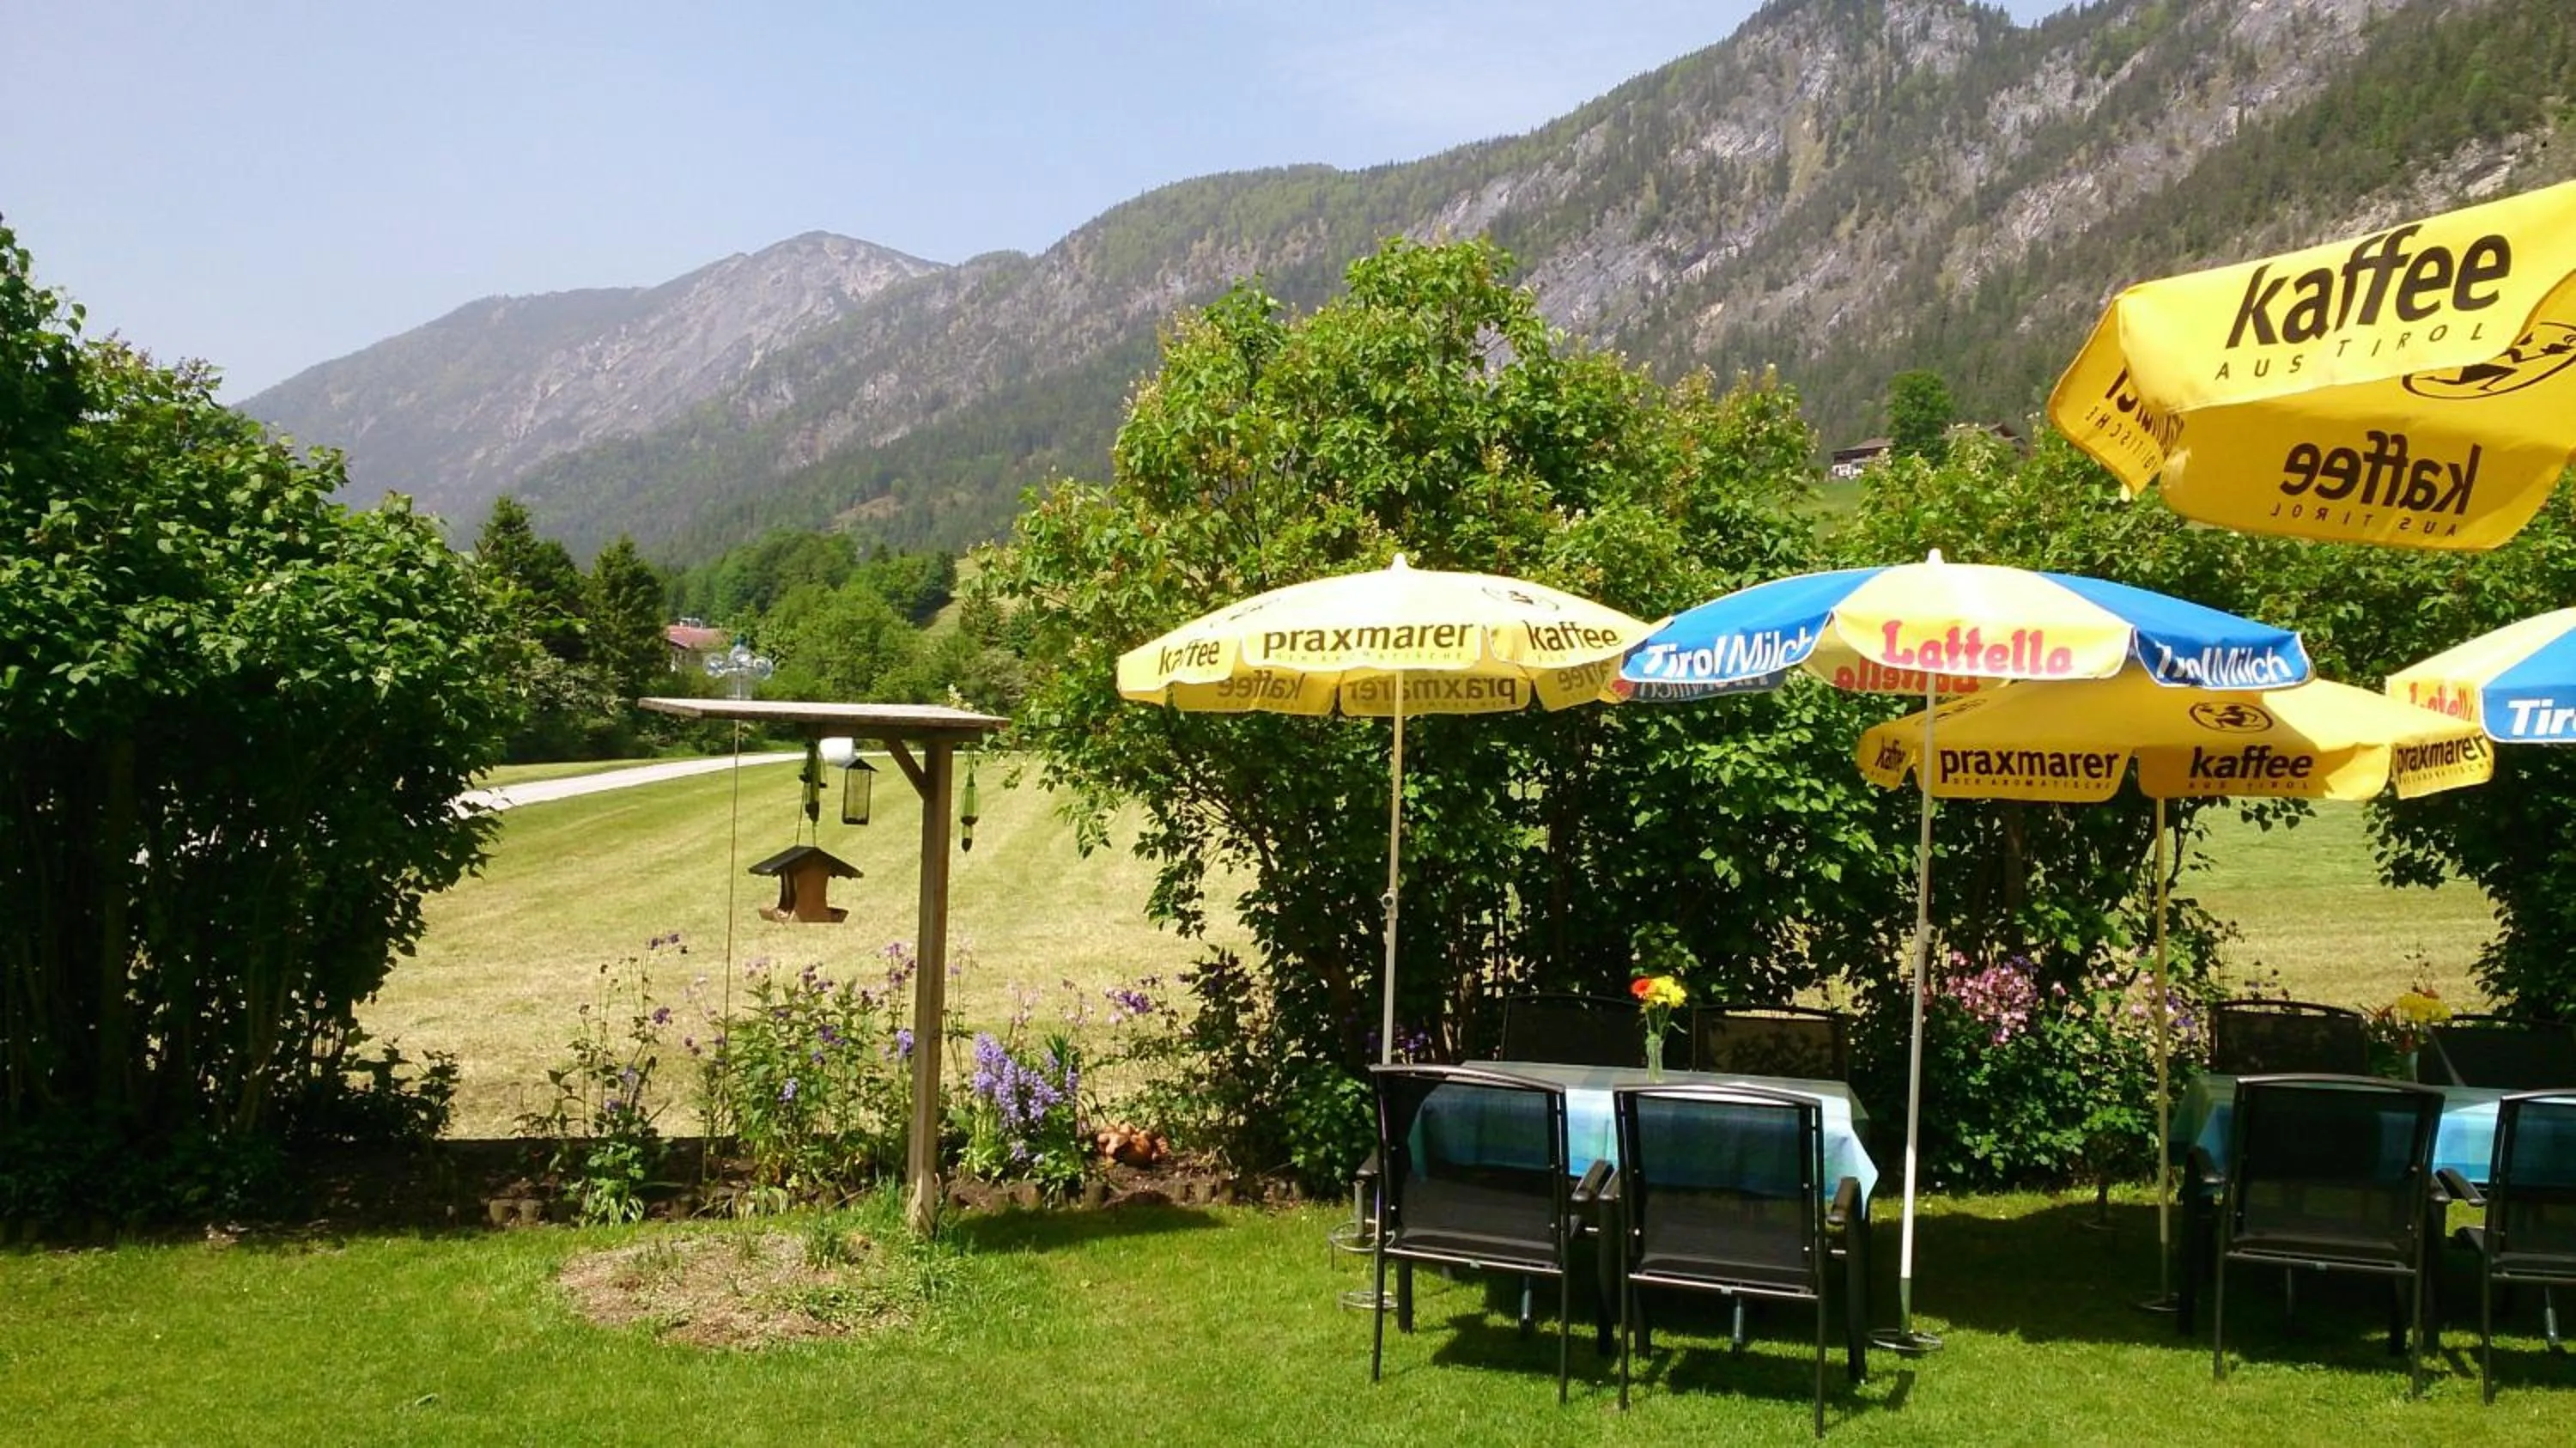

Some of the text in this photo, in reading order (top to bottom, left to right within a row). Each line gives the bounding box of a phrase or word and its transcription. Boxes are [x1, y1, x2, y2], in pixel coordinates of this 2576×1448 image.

[2226, 224, 2512, 349] kaffee
[2215, 323, 2483, 380] AUS TIROL
[1263, 624, 1474, 660] praxmarer
[1522, 620, 1623, 651] kaffee
[1881, 619, 2074, 676] Lattella
[2508, 698, 2576, 736] Tir
[1939, 749, 2120, 784] praxmarer
[2190, 744, 2314, 779] kaffee
[2397, 734, 2488, 775] praxmarer
